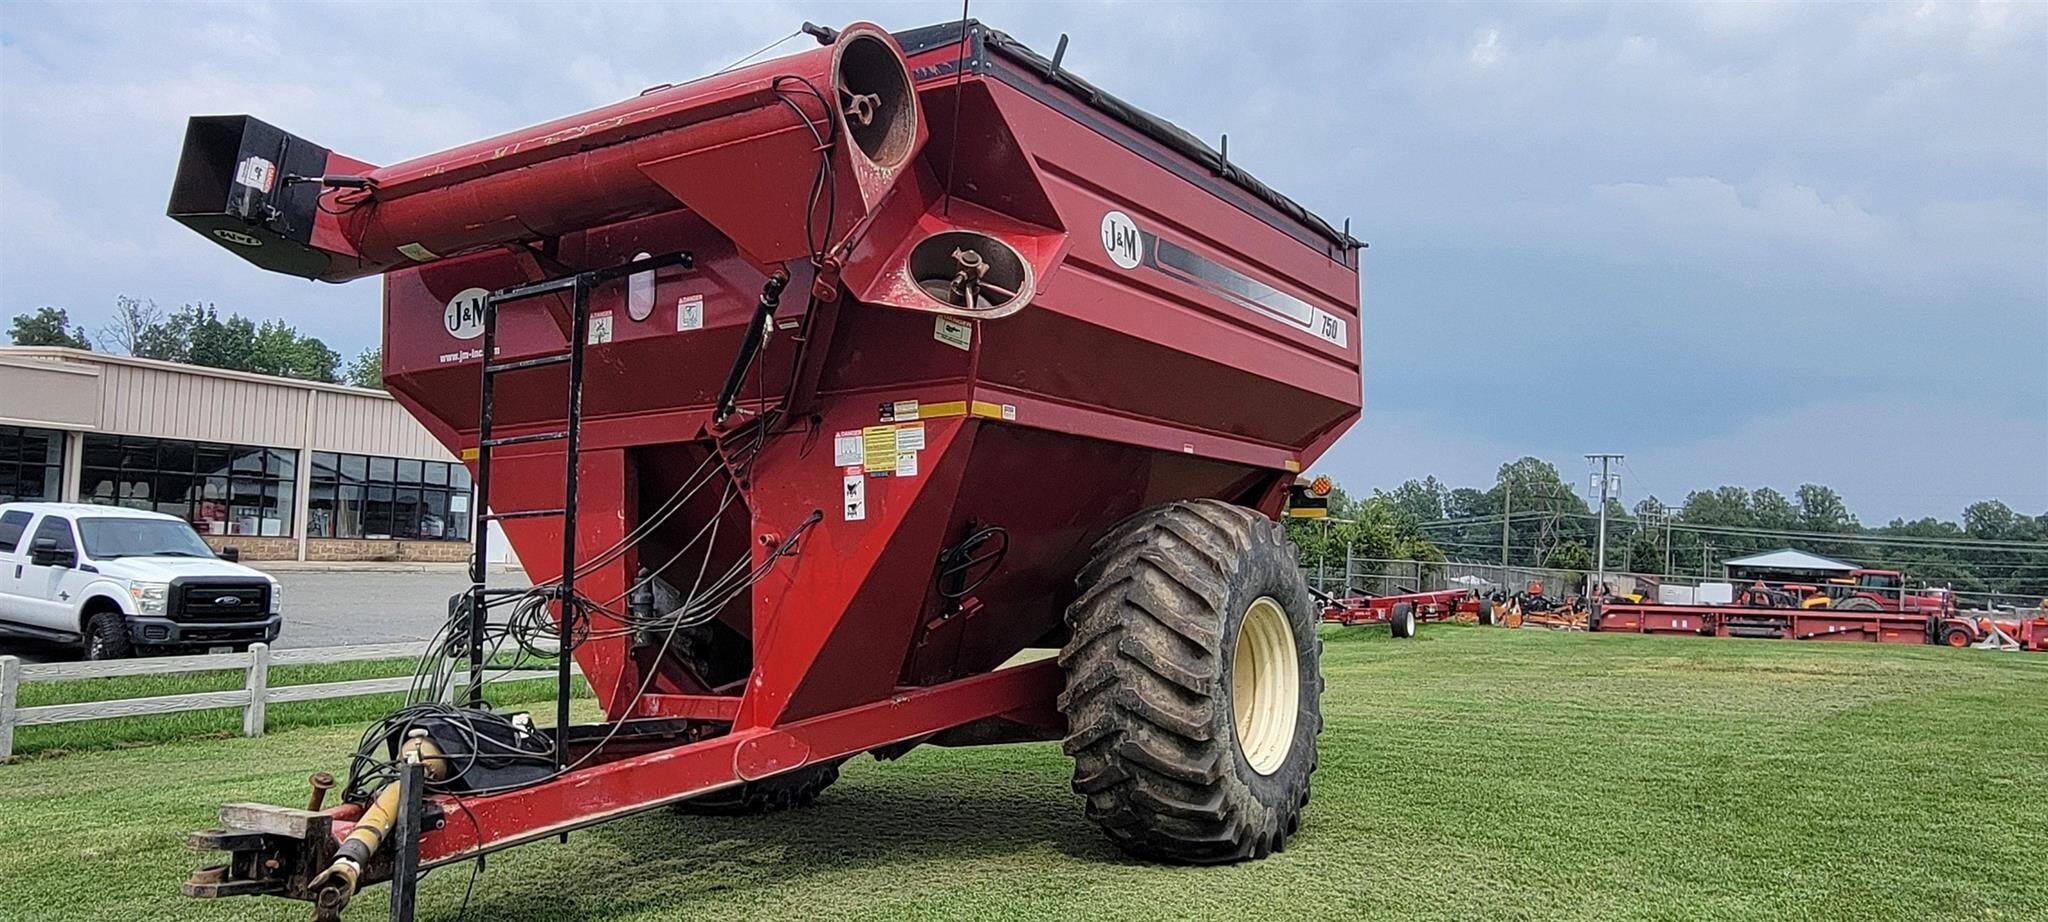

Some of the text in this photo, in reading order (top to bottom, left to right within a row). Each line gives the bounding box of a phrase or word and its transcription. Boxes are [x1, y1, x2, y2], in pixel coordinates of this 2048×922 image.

[1105, 219, 1137, 262] J&M
[448, 295, 487, 332] J&M
[1321, 315, 1338, 339] 750
[440, 347, 500, 363] www.jm-incm
